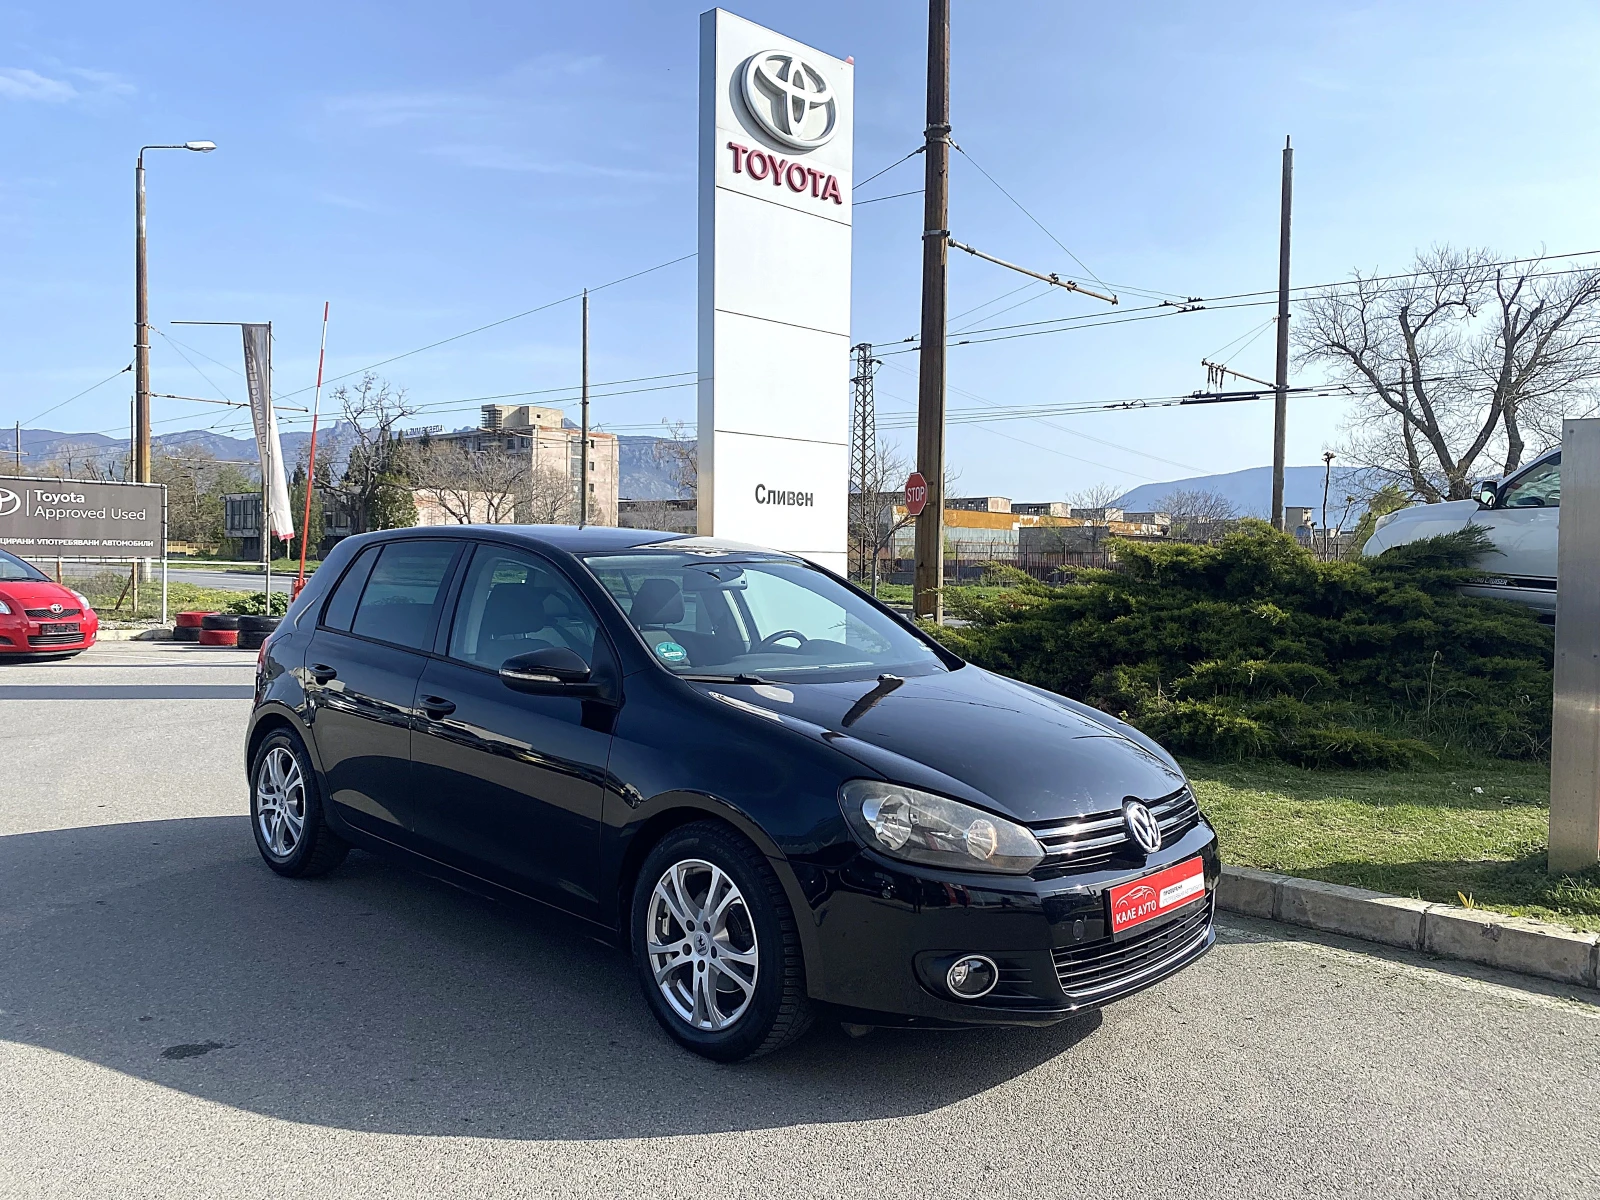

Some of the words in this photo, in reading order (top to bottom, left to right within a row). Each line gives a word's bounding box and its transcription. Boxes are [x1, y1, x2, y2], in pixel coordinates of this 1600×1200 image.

[727, 141, 842, 205] TOYOTA
[34, 489, 85, 505] Toyota
[755, 483, 814, 507] Сливен
[907, 486, 925, 503] STOP
[34, 506, 105, 520] Approved
[111, 508, 146, 521] Used
[36, 538, 100, 547] УПОТРЕБЯВАНИ
[101, 539, 154, 547] АВТОМОБИЛИ
[1115, 907, 1137, 925] КАЛЕ
[1138, 900, 1156, 915] АУТО
